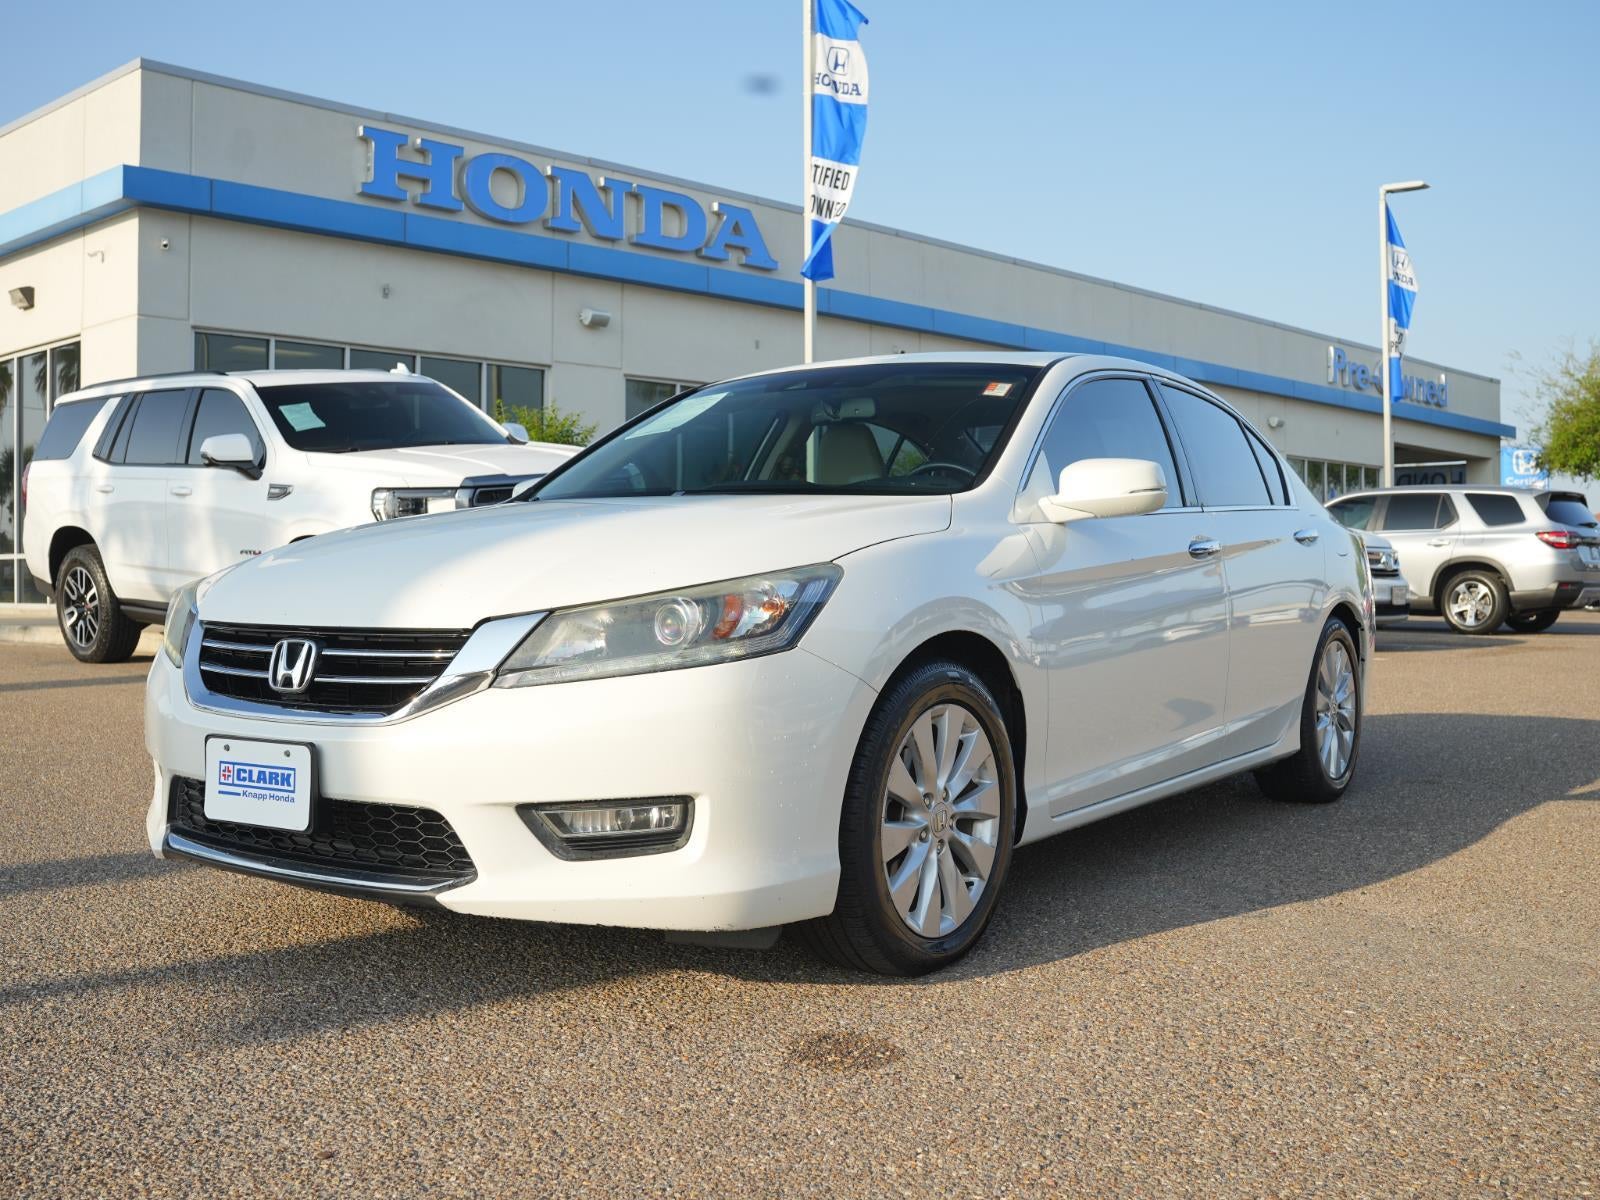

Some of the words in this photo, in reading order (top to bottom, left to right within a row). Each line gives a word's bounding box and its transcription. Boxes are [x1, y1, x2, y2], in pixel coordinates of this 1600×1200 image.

[357, 125, 778, 271] HONDA
[236, 768, 292, 787] CLARK
[242, 790, 268, 802] Knapp
[269, 793, 295, 803] Honda
